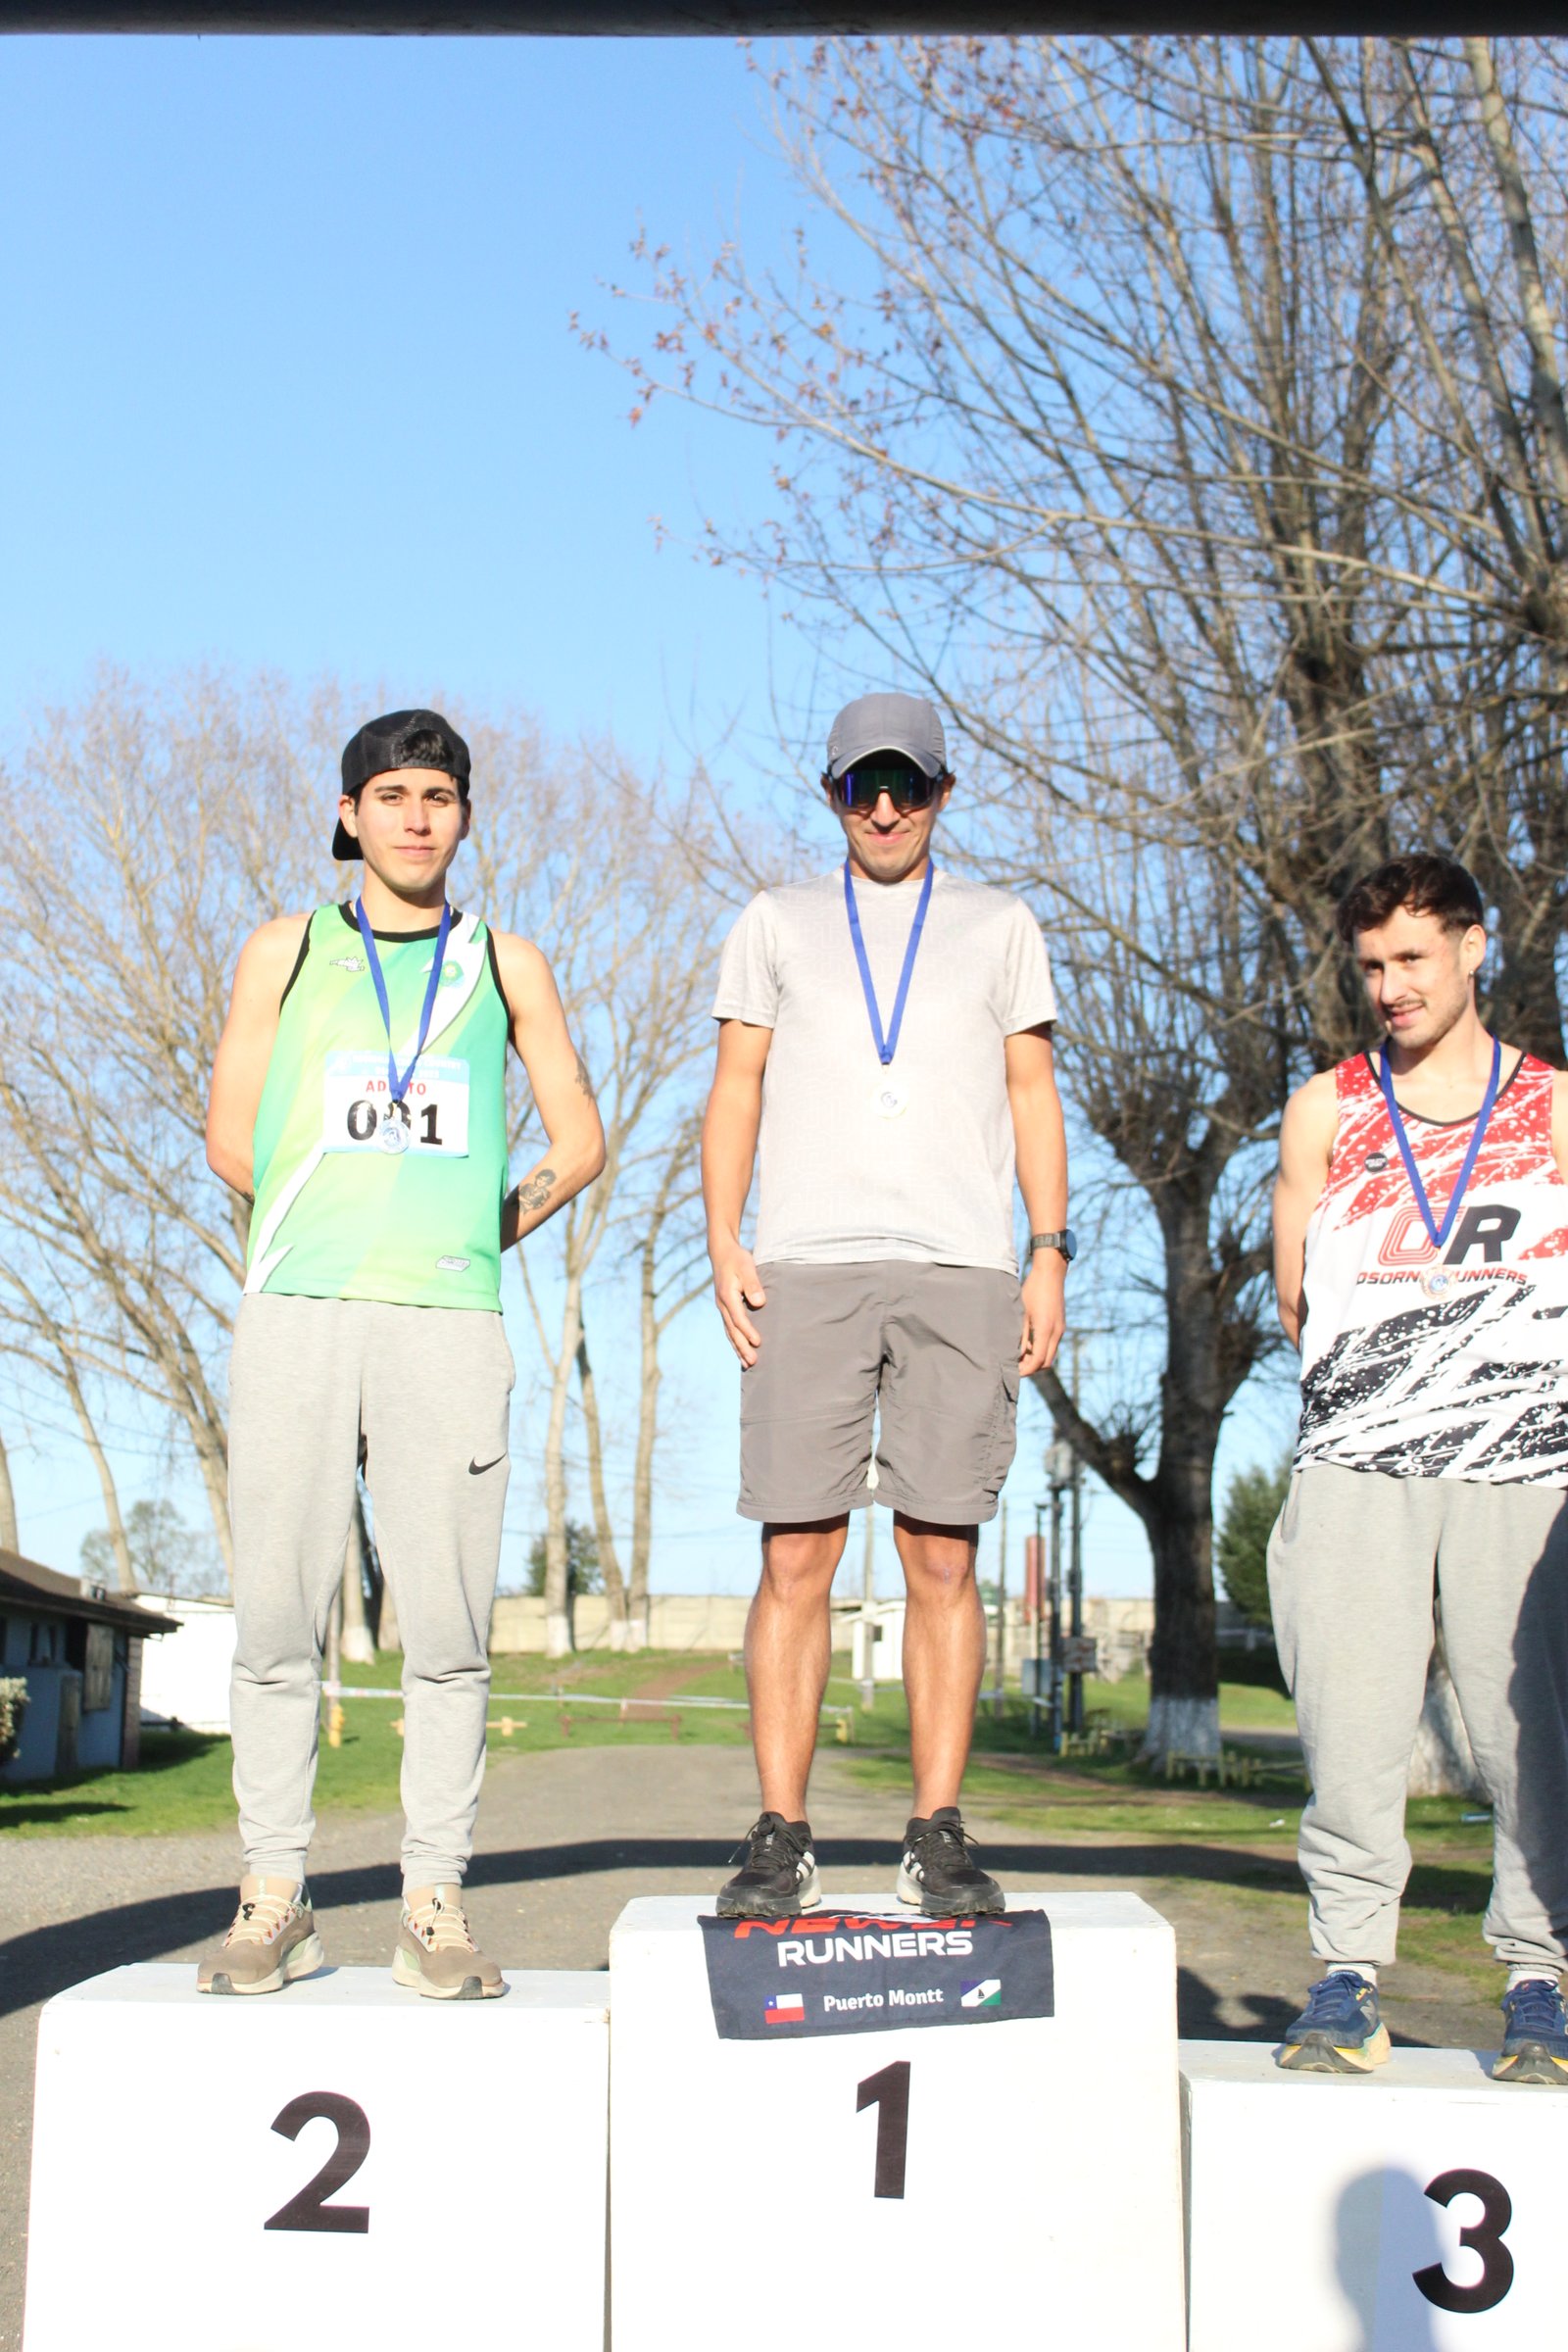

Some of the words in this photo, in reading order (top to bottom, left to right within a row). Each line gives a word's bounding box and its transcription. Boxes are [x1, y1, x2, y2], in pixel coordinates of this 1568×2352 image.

[366, 1080, 426, 1096] ADTO
[1356, 1270, 1421, 1286] OSORN
[1456, 1266, 1529, 1286] UNNERS
[777, 1930, 974, 1968] RUNNERS
[823, 1992, 885, 2012] Puerto
[888, 1988, 945, 2007] Montt
[857, 2062, 910, 2199] 1
[265, 2092, 369, 2233] 2
[1412, 2170, 1514, 2314] 3
